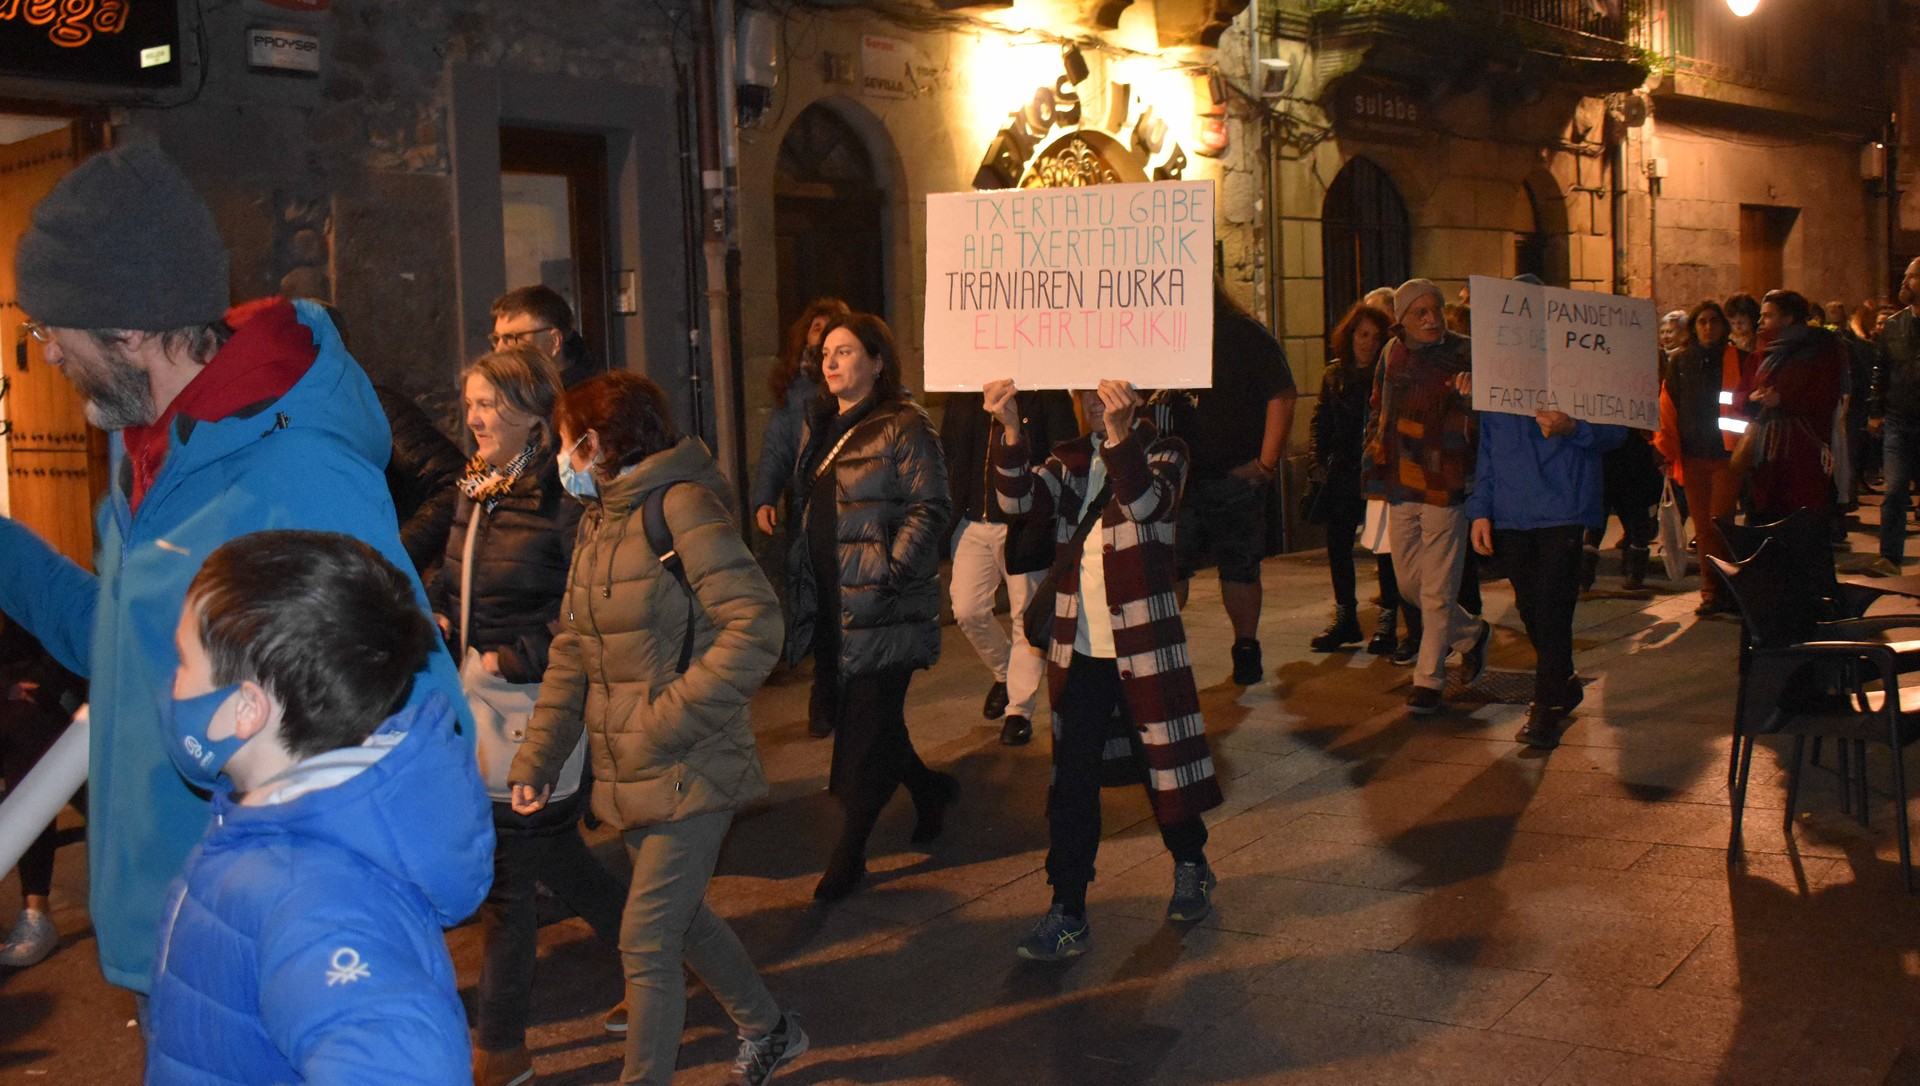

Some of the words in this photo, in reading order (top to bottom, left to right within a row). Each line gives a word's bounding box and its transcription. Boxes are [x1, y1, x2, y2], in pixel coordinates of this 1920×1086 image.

[1354, 93, 1418, 121] sulabe
[966, 192, 1115, 230] TXERTATU
[1129, 189, 1207, 224] GABE
[963, 233, 1004, 270] ALA
[1014, 226, 1199, 269] TXERTATURIK
[945, 269, 1084, 310] TIRANIAREN
[1097, 269, 1185, 309] AURKA
[974, 310, 1188, 352] ELKARTURIK!!!
[1501, 295, 1533, 320] LA
[1547, 300, 1642, 329] PANDEMIA
[1573, 391, 1625, 420] HUTSA
